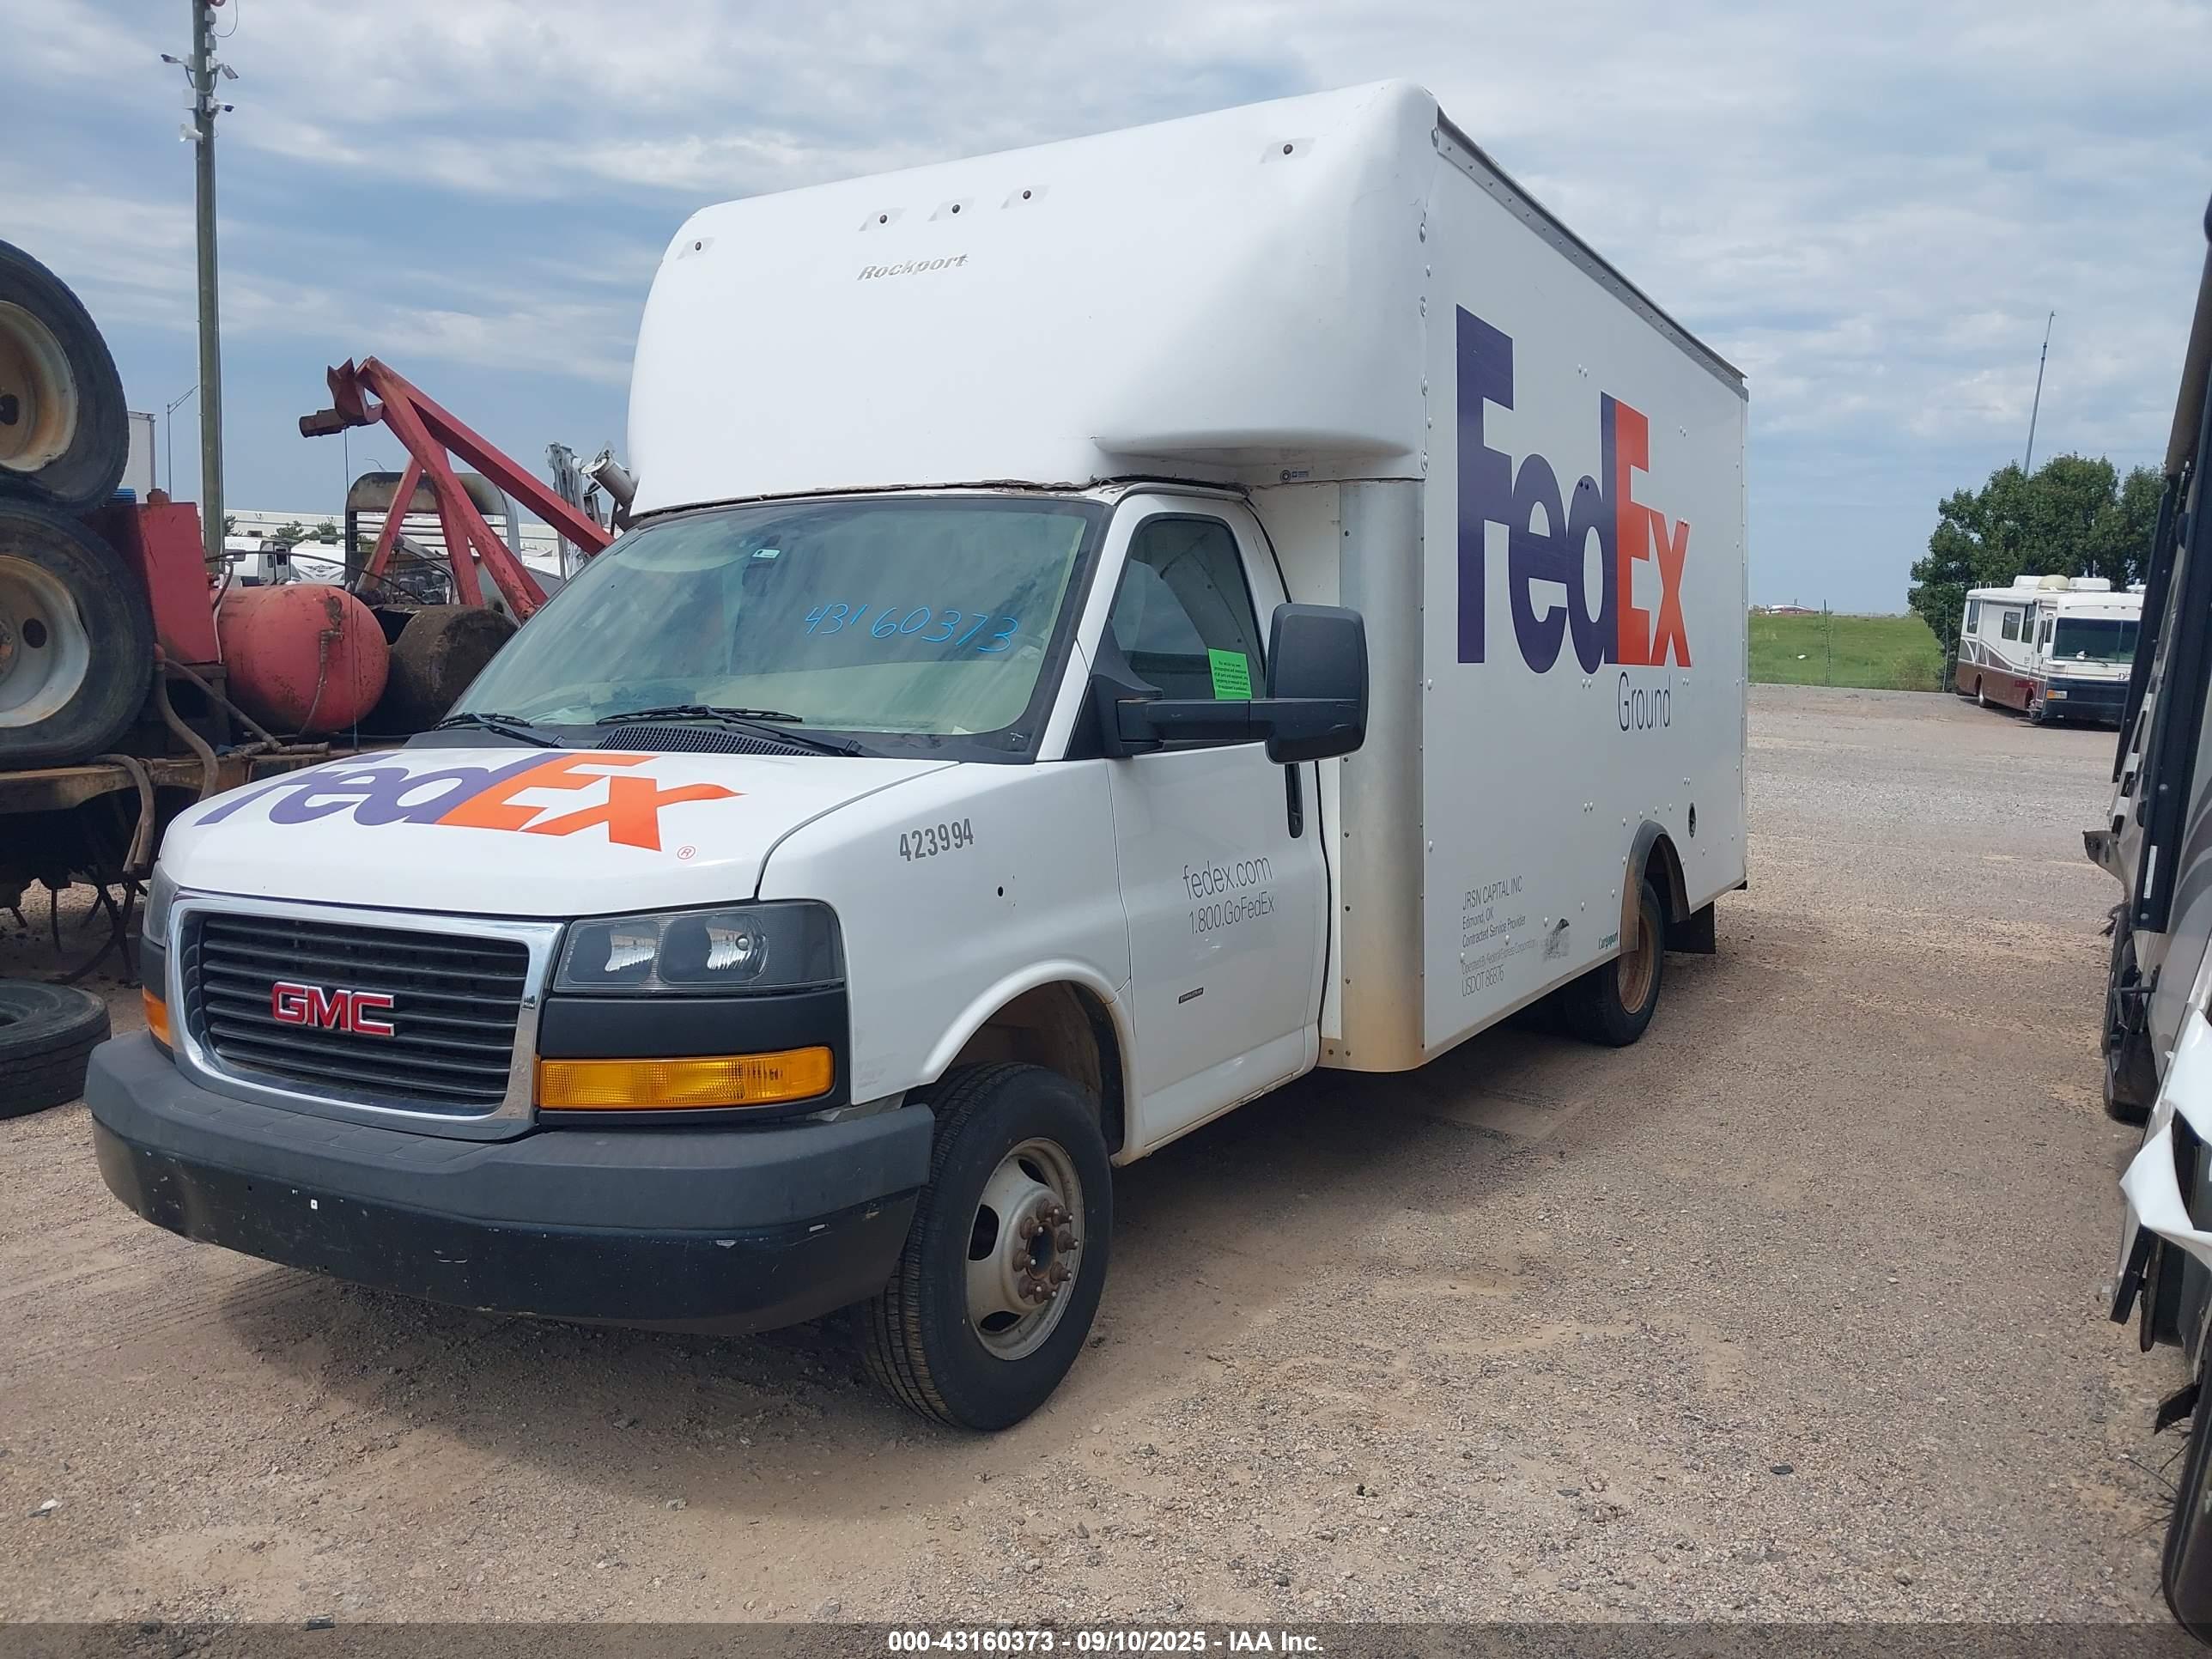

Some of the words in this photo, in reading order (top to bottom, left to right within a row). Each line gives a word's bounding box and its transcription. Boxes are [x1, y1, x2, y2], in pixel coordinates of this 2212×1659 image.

[857, 253, 969, 281] Rockport
[1455, 304, 1692, 674] FedEx
[1617, 671, 1671, 732] Ground
[193, 752, 749, 852] FedEx
[899, 817, 974, 862] 423994
[1182, 857, 1273, 900] fedex.com
[1462, 889, 1482, 911] JRSN
[1482, 881, 1510, 904] CAPITAL
[1510, 875, 1523, 895] INC
[1188, 890, 1274, 934] 1.800.GoFedEx
[1462, 971, 1486, 997] USDOT
[272, 981, 395, 1037] GMC
